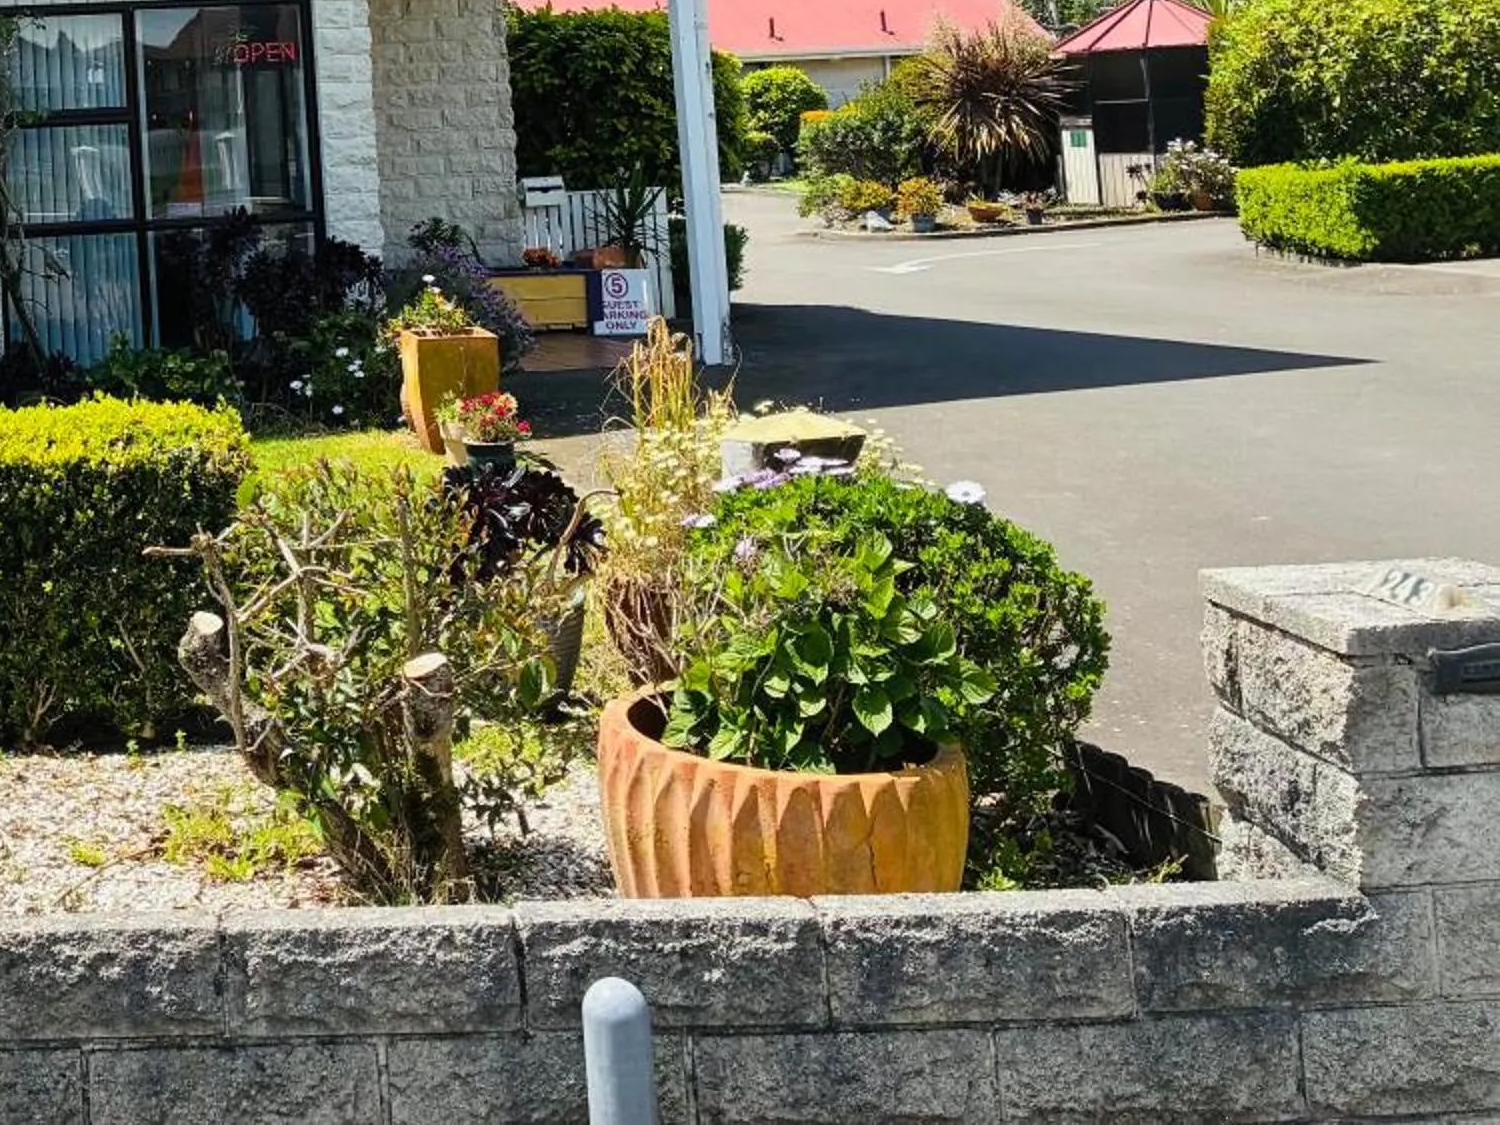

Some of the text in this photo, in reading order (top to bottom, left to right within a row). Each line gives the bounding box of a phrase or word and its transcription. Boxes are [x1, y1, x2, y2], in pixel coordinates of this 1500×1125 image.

[233, 41, 296, 63] OPEN
[611, 277, 623, 294] 5
[605, 321, 637, 330] ONLY
